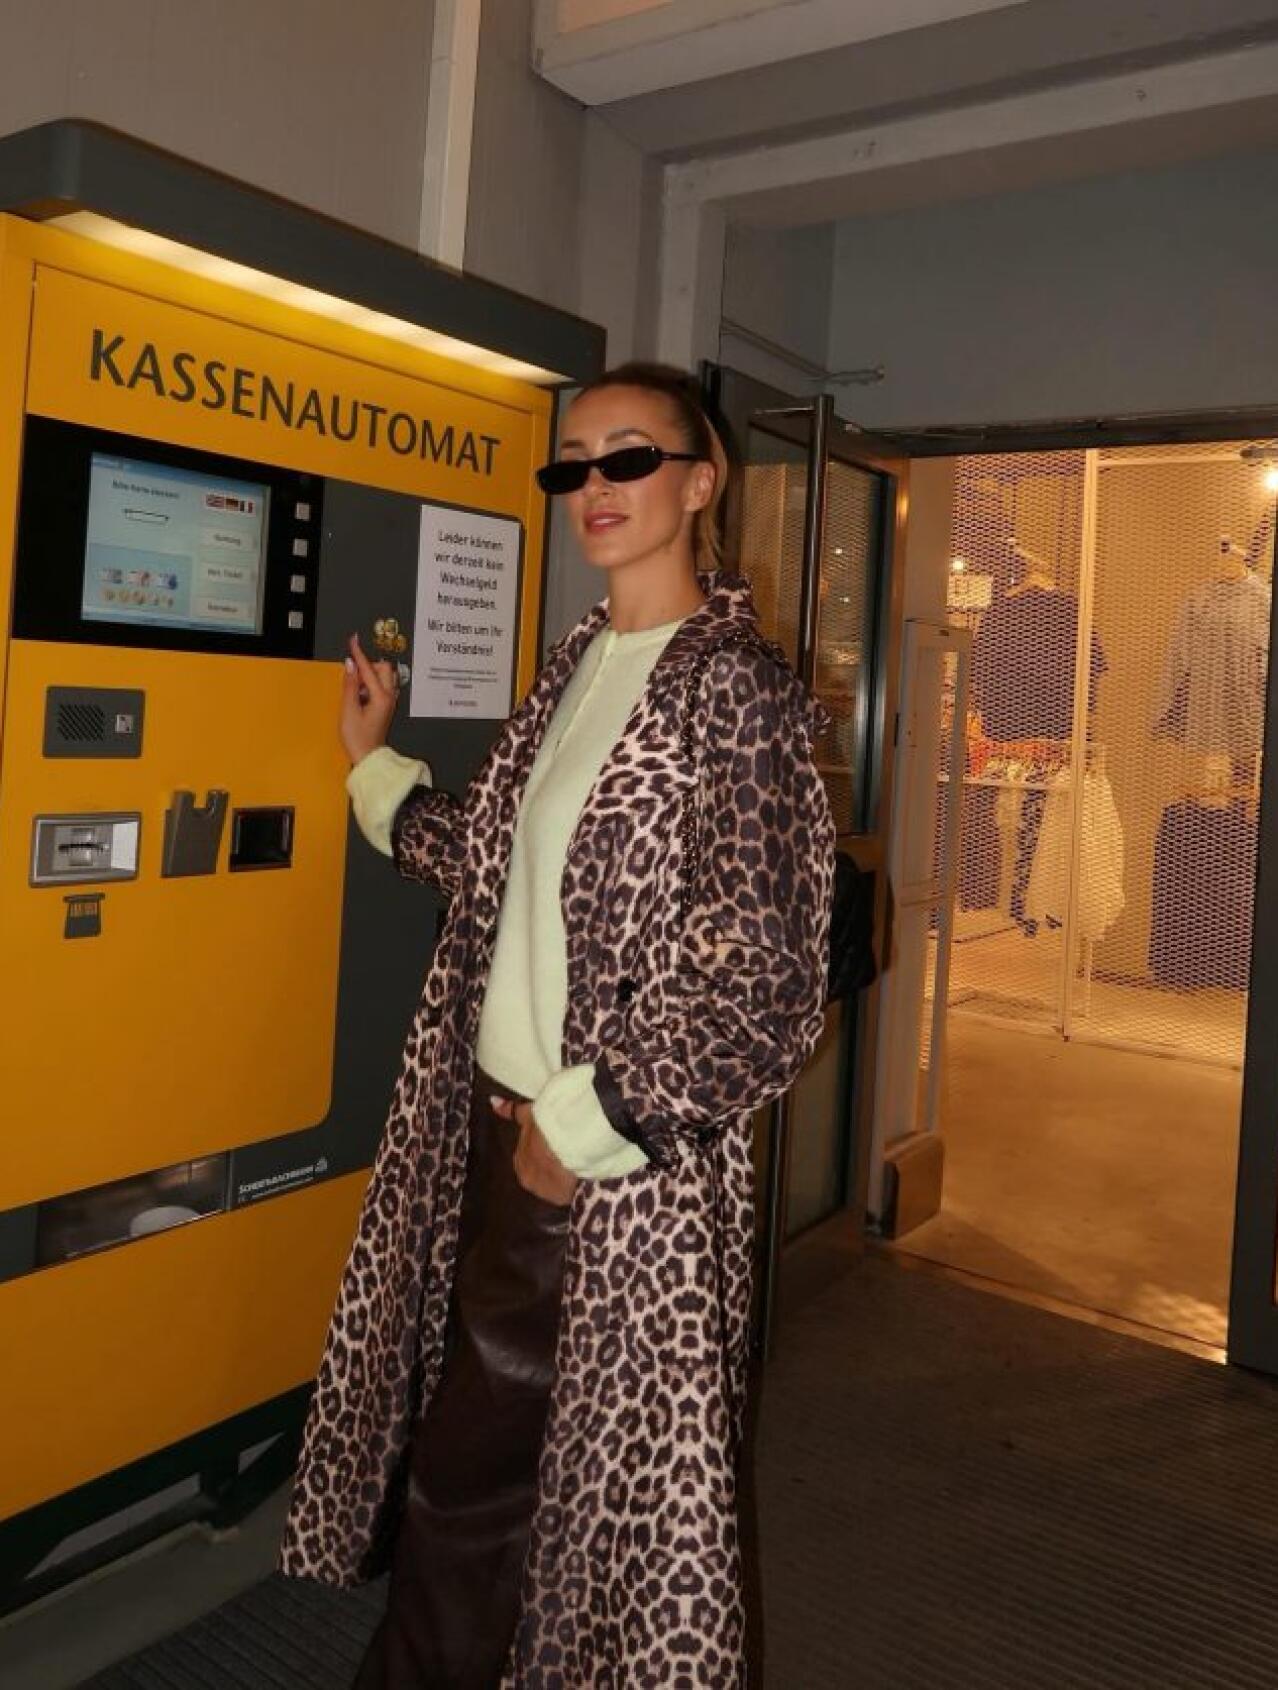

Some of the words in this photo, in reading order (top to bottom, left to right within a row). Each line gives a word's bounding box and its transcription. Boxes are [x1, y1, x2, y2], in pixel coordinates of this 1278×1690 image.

[90, 328, 501, 477] KASSENAUTOMAT
[438, 530, 469, 546] Leider
[470, 534, 504, 551] können
[434, 552, 451, 563] wir
[452, 553, 484, 569] derzeit
[486, 558, 504, 571] kein
[440, 570, 498, 592] Wechselgeld
[427, 616, 444, 631] Wir
[446, 621, 473, 635] bitten
[474, 625, 489, 637] um
